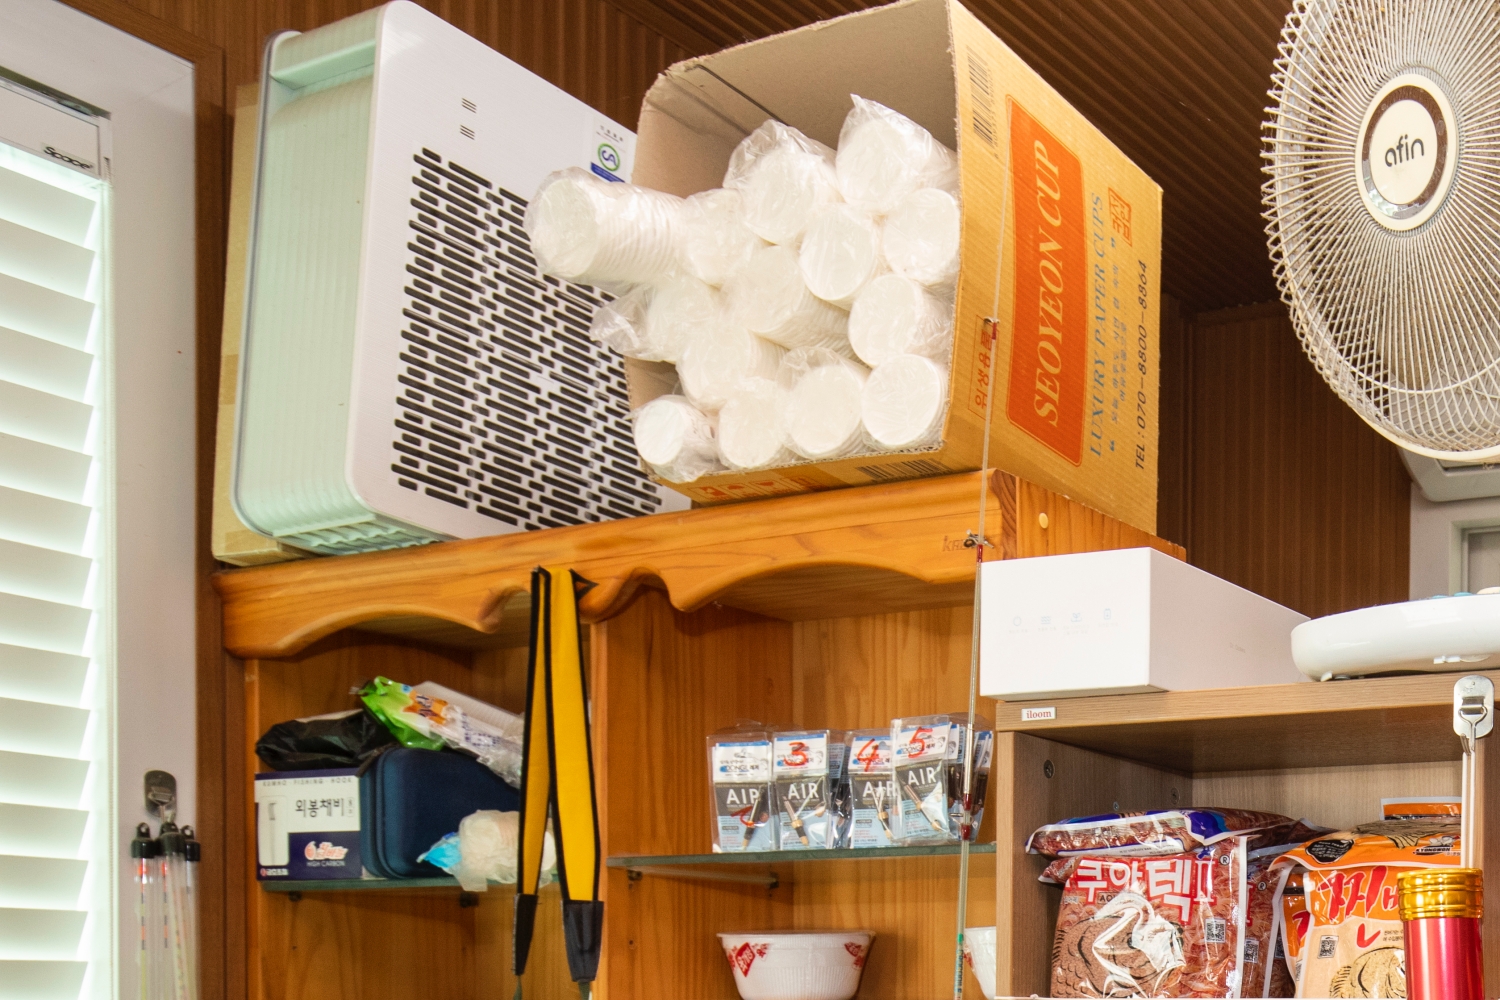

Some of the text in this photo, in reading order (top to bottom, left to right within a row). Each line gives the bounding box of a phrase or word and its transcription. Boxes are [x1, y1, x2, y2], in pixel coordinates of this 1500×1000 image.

[1384, 134, 1424, 167] afin
[1033, 140, 1064, 427] SEOYEON CUP
[1090, 193, 1106, 457] LUXURY PAPER CUPS
[1026, 710, 1053, 720] iloom
[784, 742, 807, 767] 3
[857, 738, 879, 772] 4
[908, 727, 933, 758] 5
[907, 766, 937, 786] AIR
[788, 783, 819, 800] AIR
[295, 797, 345, 818] 외봉채비
